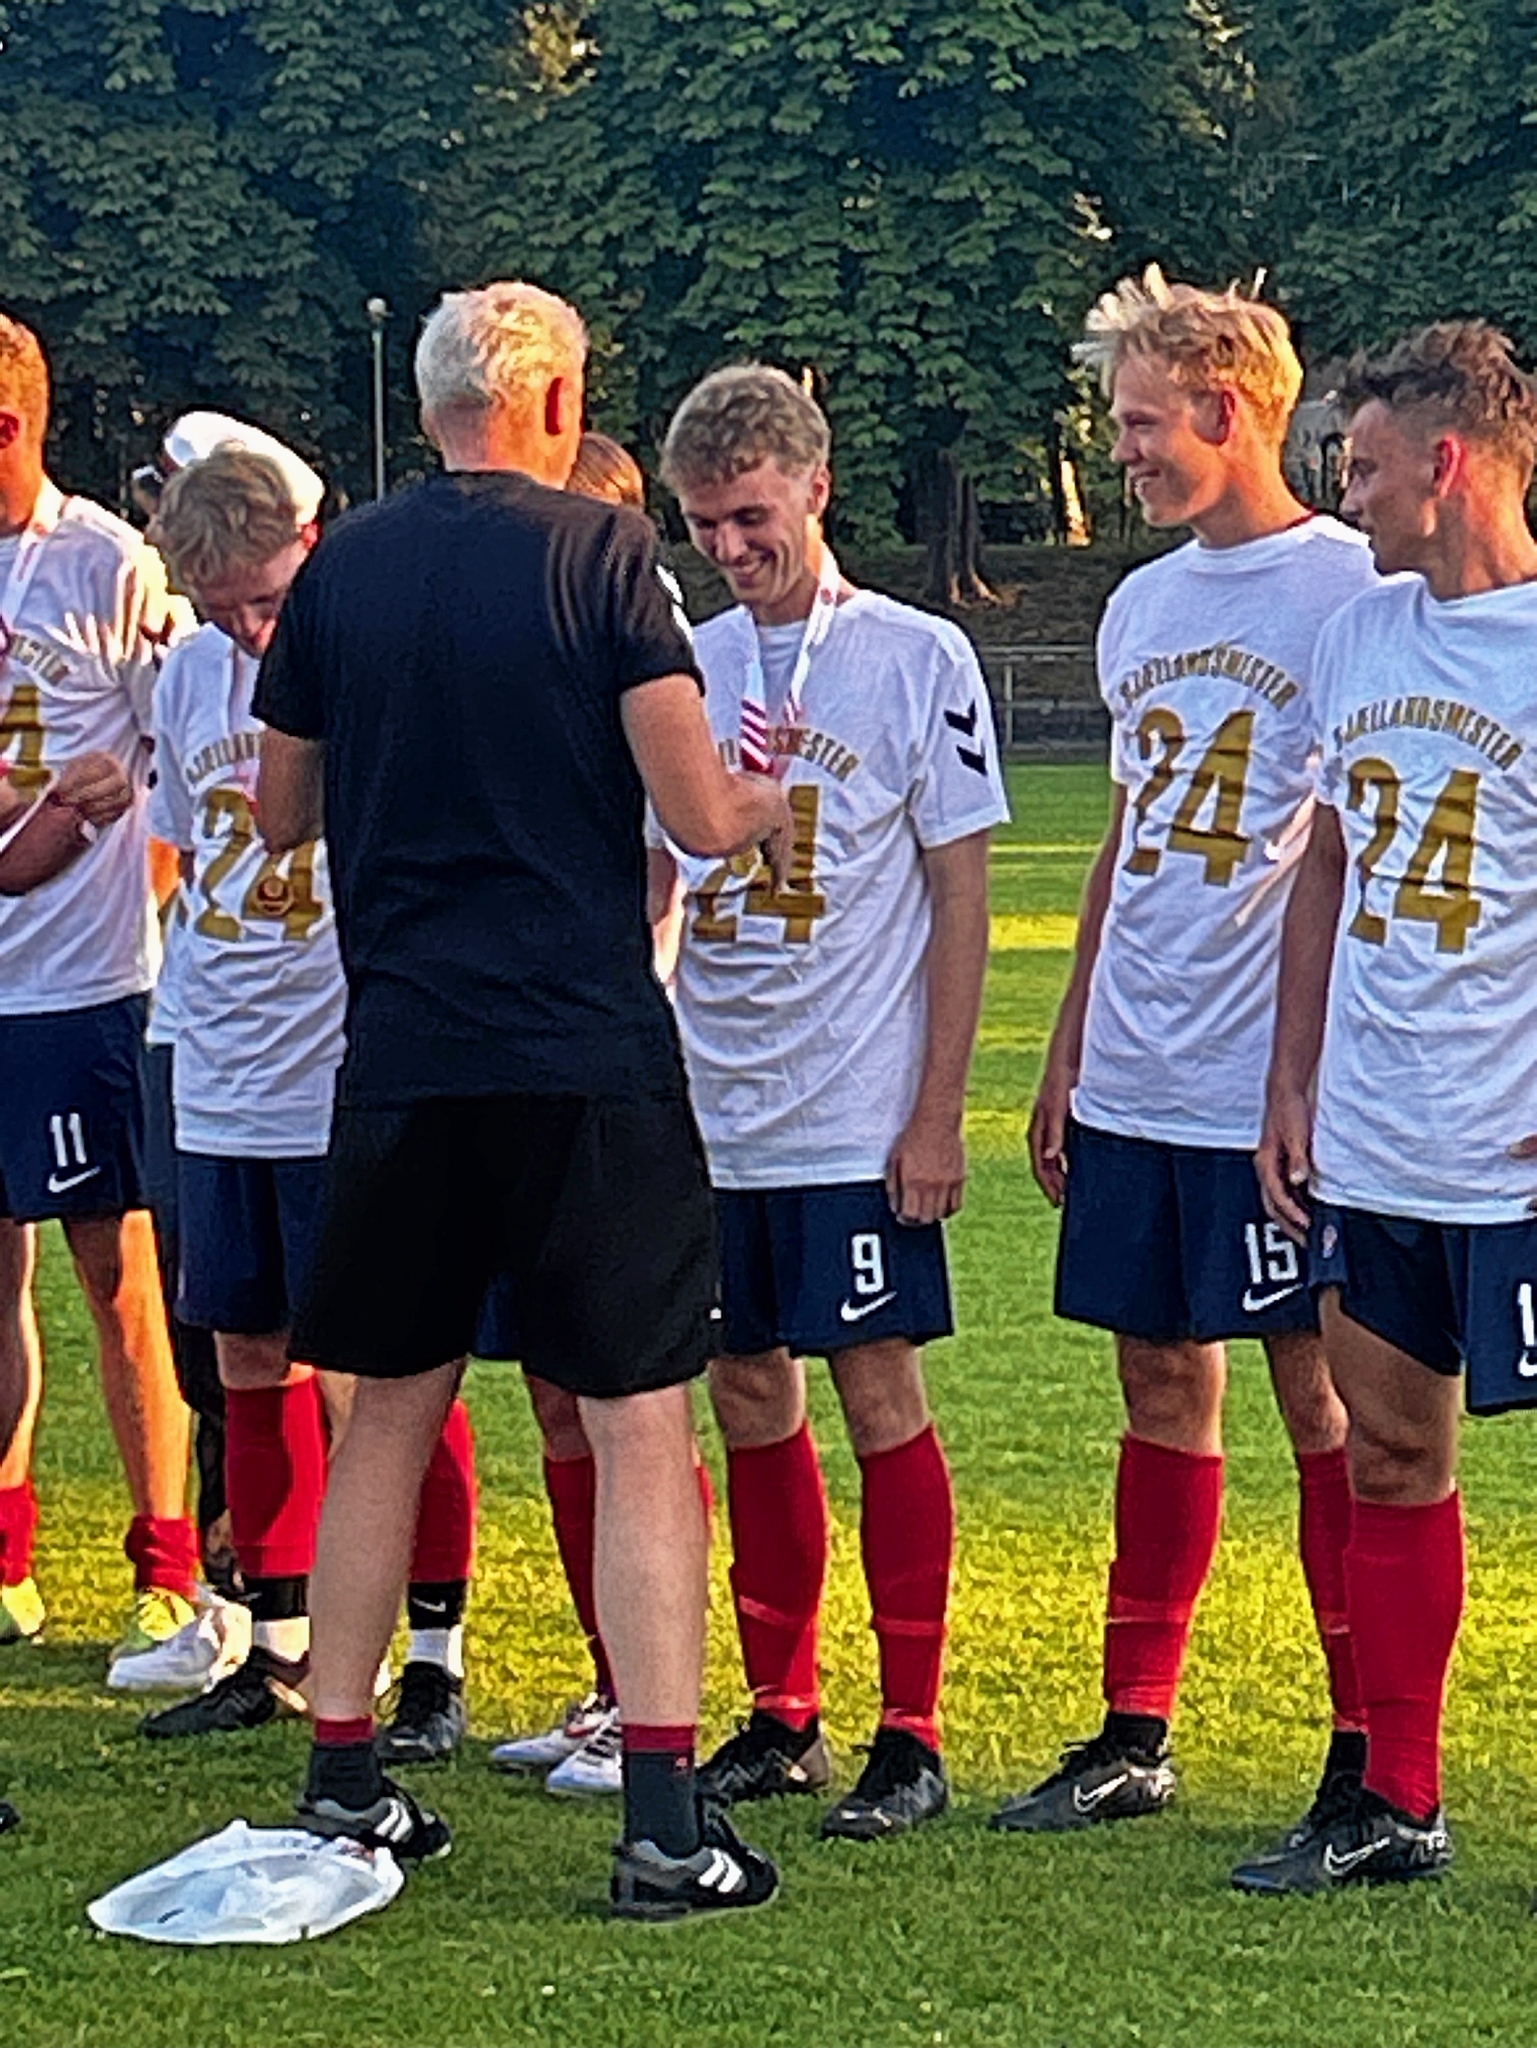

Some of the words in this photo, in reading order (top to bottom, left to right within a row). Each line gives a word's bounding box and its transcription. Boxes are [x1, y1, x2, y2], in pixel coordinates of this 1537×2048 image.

[1122, 707, 1256, 887] 24
[1346, 757, 1481, 953] 24
[50, 1112, 87, 1167] 11
[851, 1233, 885, 1294] 9
[1244, 1222, 1299, 1283] 15
[1517, 1283, 1537, 1347] 1
